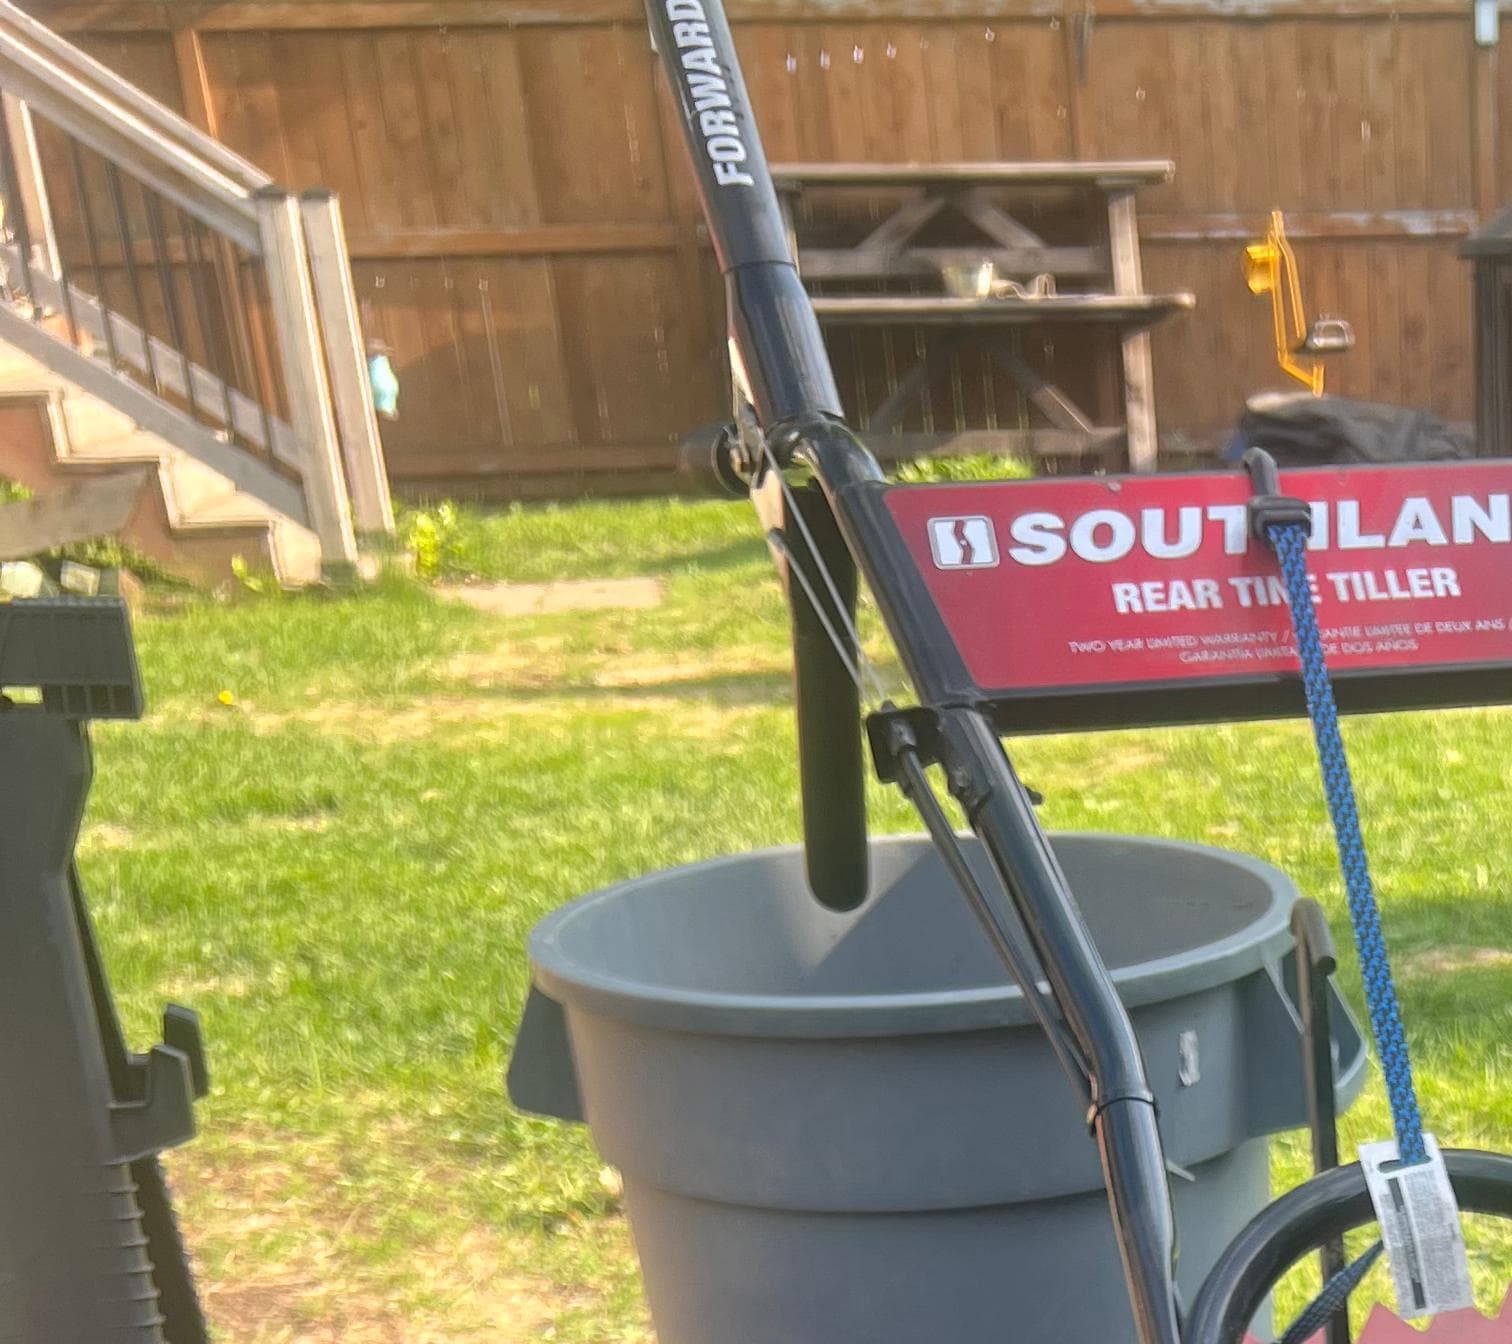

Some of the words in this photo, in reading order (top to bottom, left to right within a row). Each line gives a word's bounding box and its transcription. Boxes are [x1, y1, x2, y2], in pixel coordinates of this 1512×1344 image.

[665, 0, 755, 187] FORWARD
[1111, 578, 1224, 614] REAR
[1327, 566, 1462, 603] TILLER
[1068, 640, 1106, 654] TWO
[1108, 637, 1143, 652] YEAR
[1147, 633, 1198, 650] LIMITED
